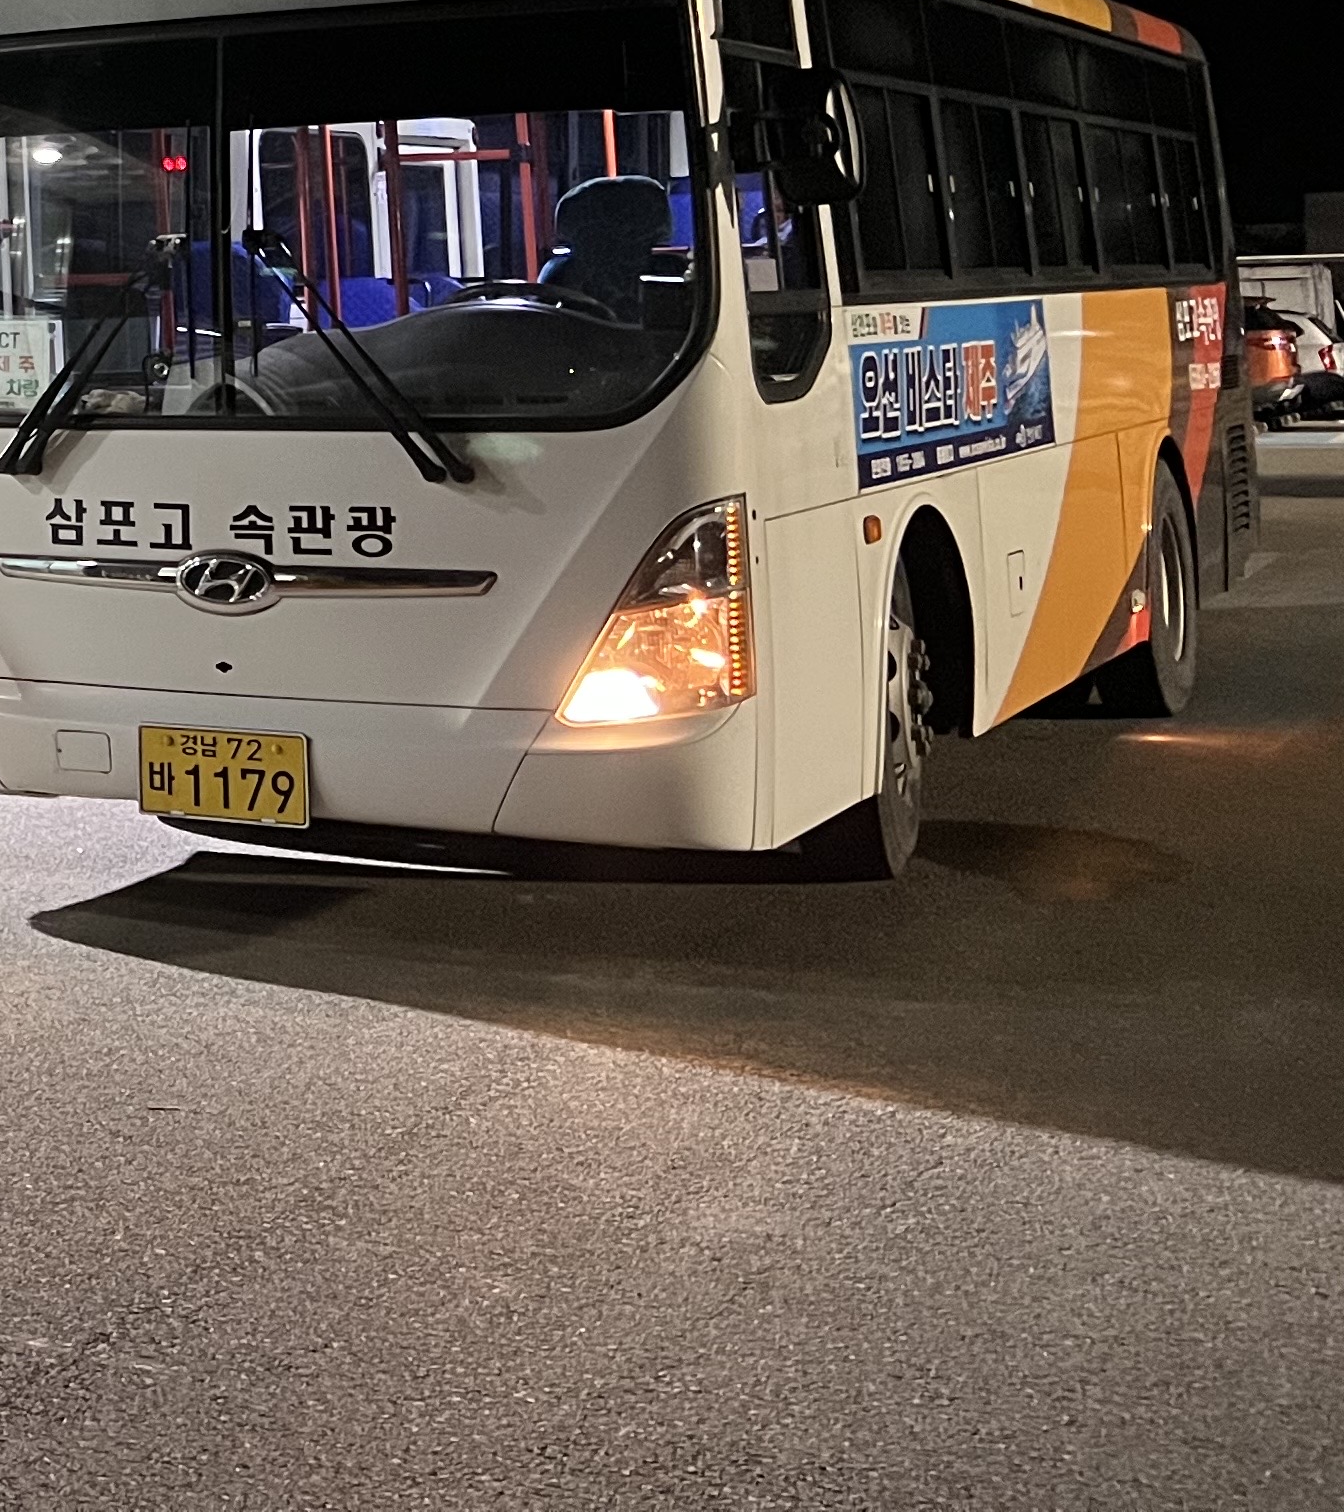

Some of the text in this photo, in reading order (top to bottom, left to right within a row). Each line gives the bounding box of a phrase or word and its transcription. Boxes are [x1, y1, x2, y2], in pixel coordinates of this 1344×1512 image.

[6, 378, 40, 397] 차량
[860, 340, 998, 439] 오션 비스타 제주
